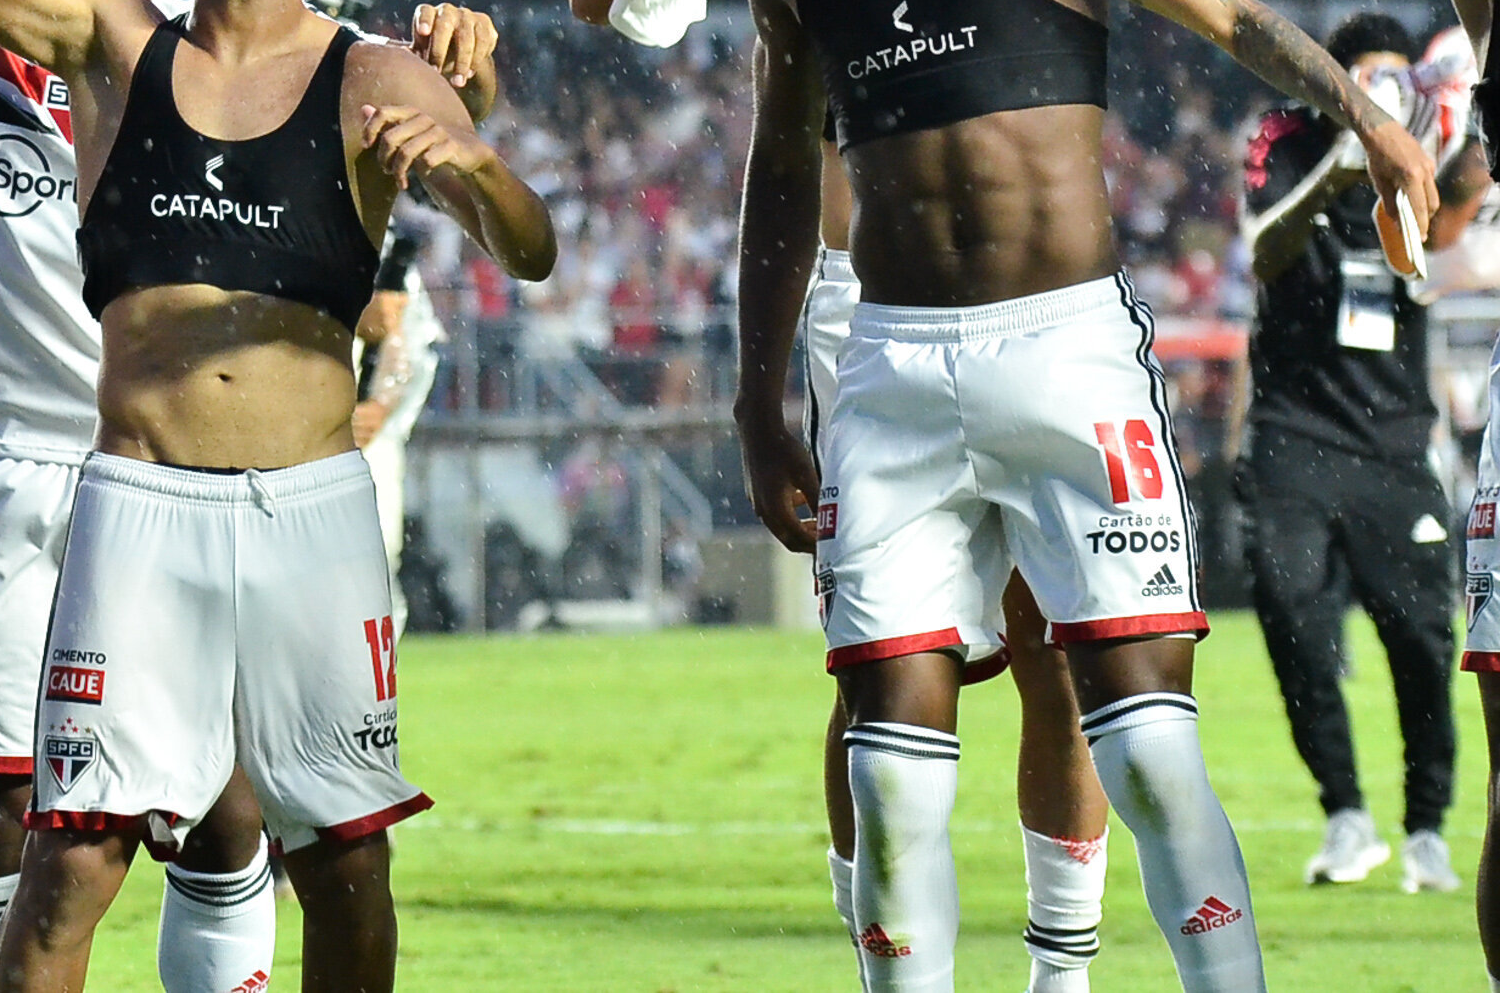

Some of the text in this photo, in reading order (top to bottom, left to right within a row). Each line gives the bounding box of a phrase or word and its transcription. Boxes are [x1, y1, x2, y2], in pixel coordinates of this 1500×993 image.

[848, 26, 977, 79] CATAPULT
[150, 194, 284, 229] CATAPULT
[1093, 419, 1163, 504] 16
[1099, 513, 1171, 528] Cartão de
[1086, 530, 1180, 554] TODOS
[1141, 584, 1183, 597] adidas
[52, 647, 106, 665] CIMENTO
[363, 615, 396, 703] 12
[49, 671, 100, 698] CAUÊ
[48, 739, 93, 757] SPFC
[1179, 907, 1243, 937] adidas
